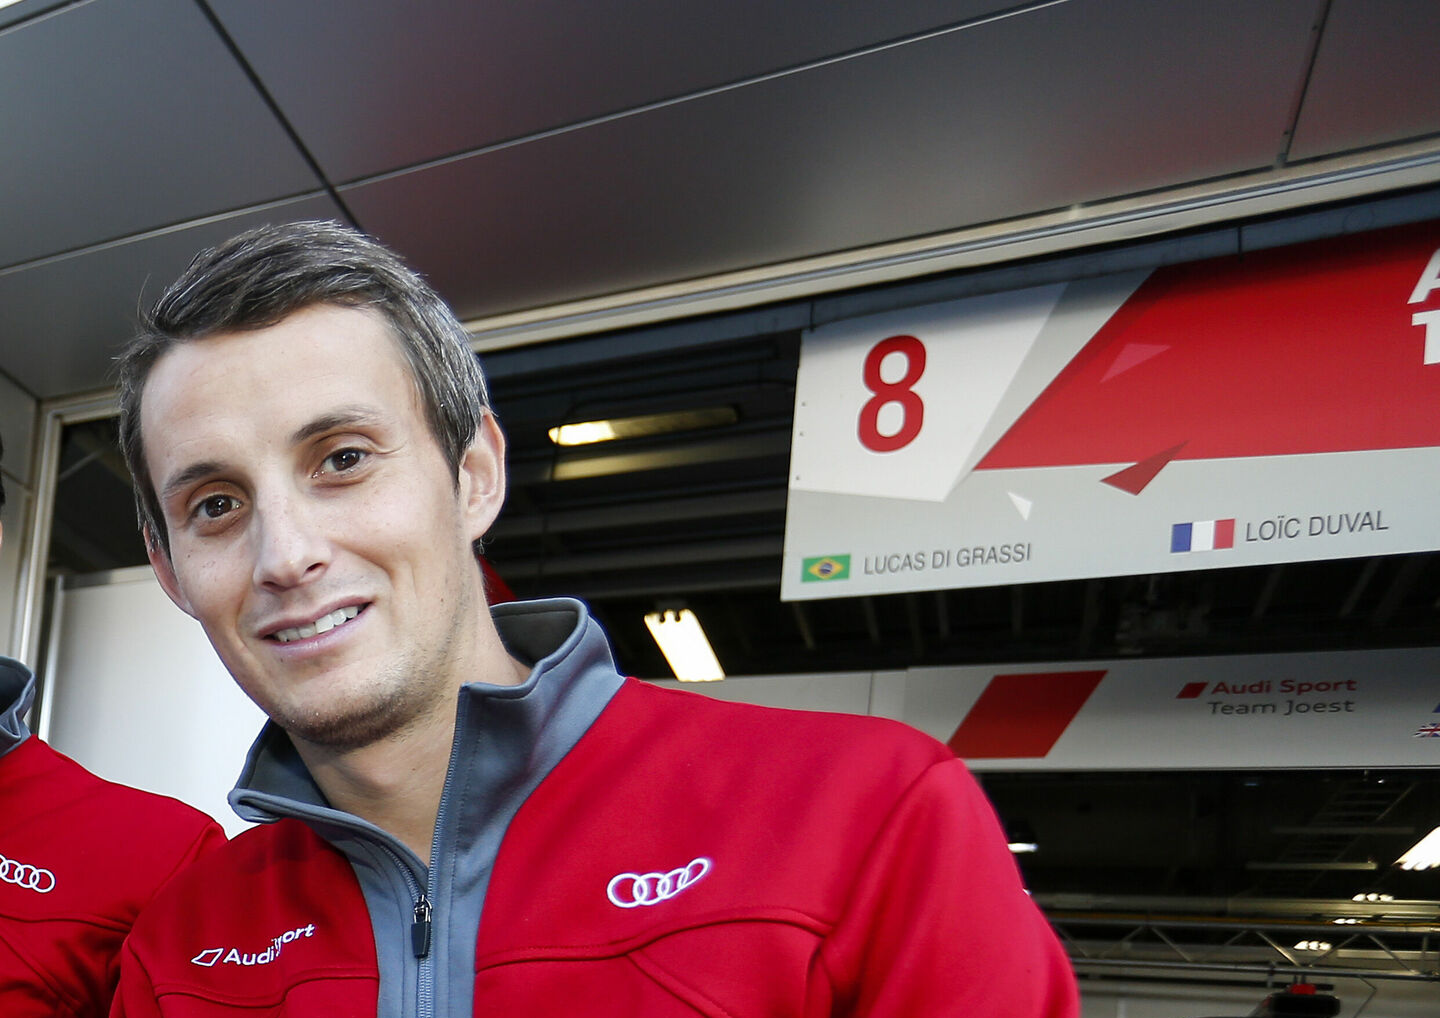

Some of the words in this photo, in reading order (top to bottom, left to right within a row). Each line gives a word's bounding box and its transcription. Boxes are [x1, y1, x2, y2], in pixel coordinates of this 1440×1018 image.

[857, 335, 927, 453] 8
[1245, 515, 1302, 543] LOÏC
[1308, 511, 1390, 538] DUVAL
[863, 552, 926, 576] LUCAS
[931, 550, 951, 570] DI
[956, 543, 1032, 569] GRASSI
[1211, 680, 1272, 695] Audi
[1279, 679, 1358, 696] Sport
[1208, 701, 1277, 715] Team
[1283, 700, 1356, 716] Joest
[222, 946, 275, 965] Audi
